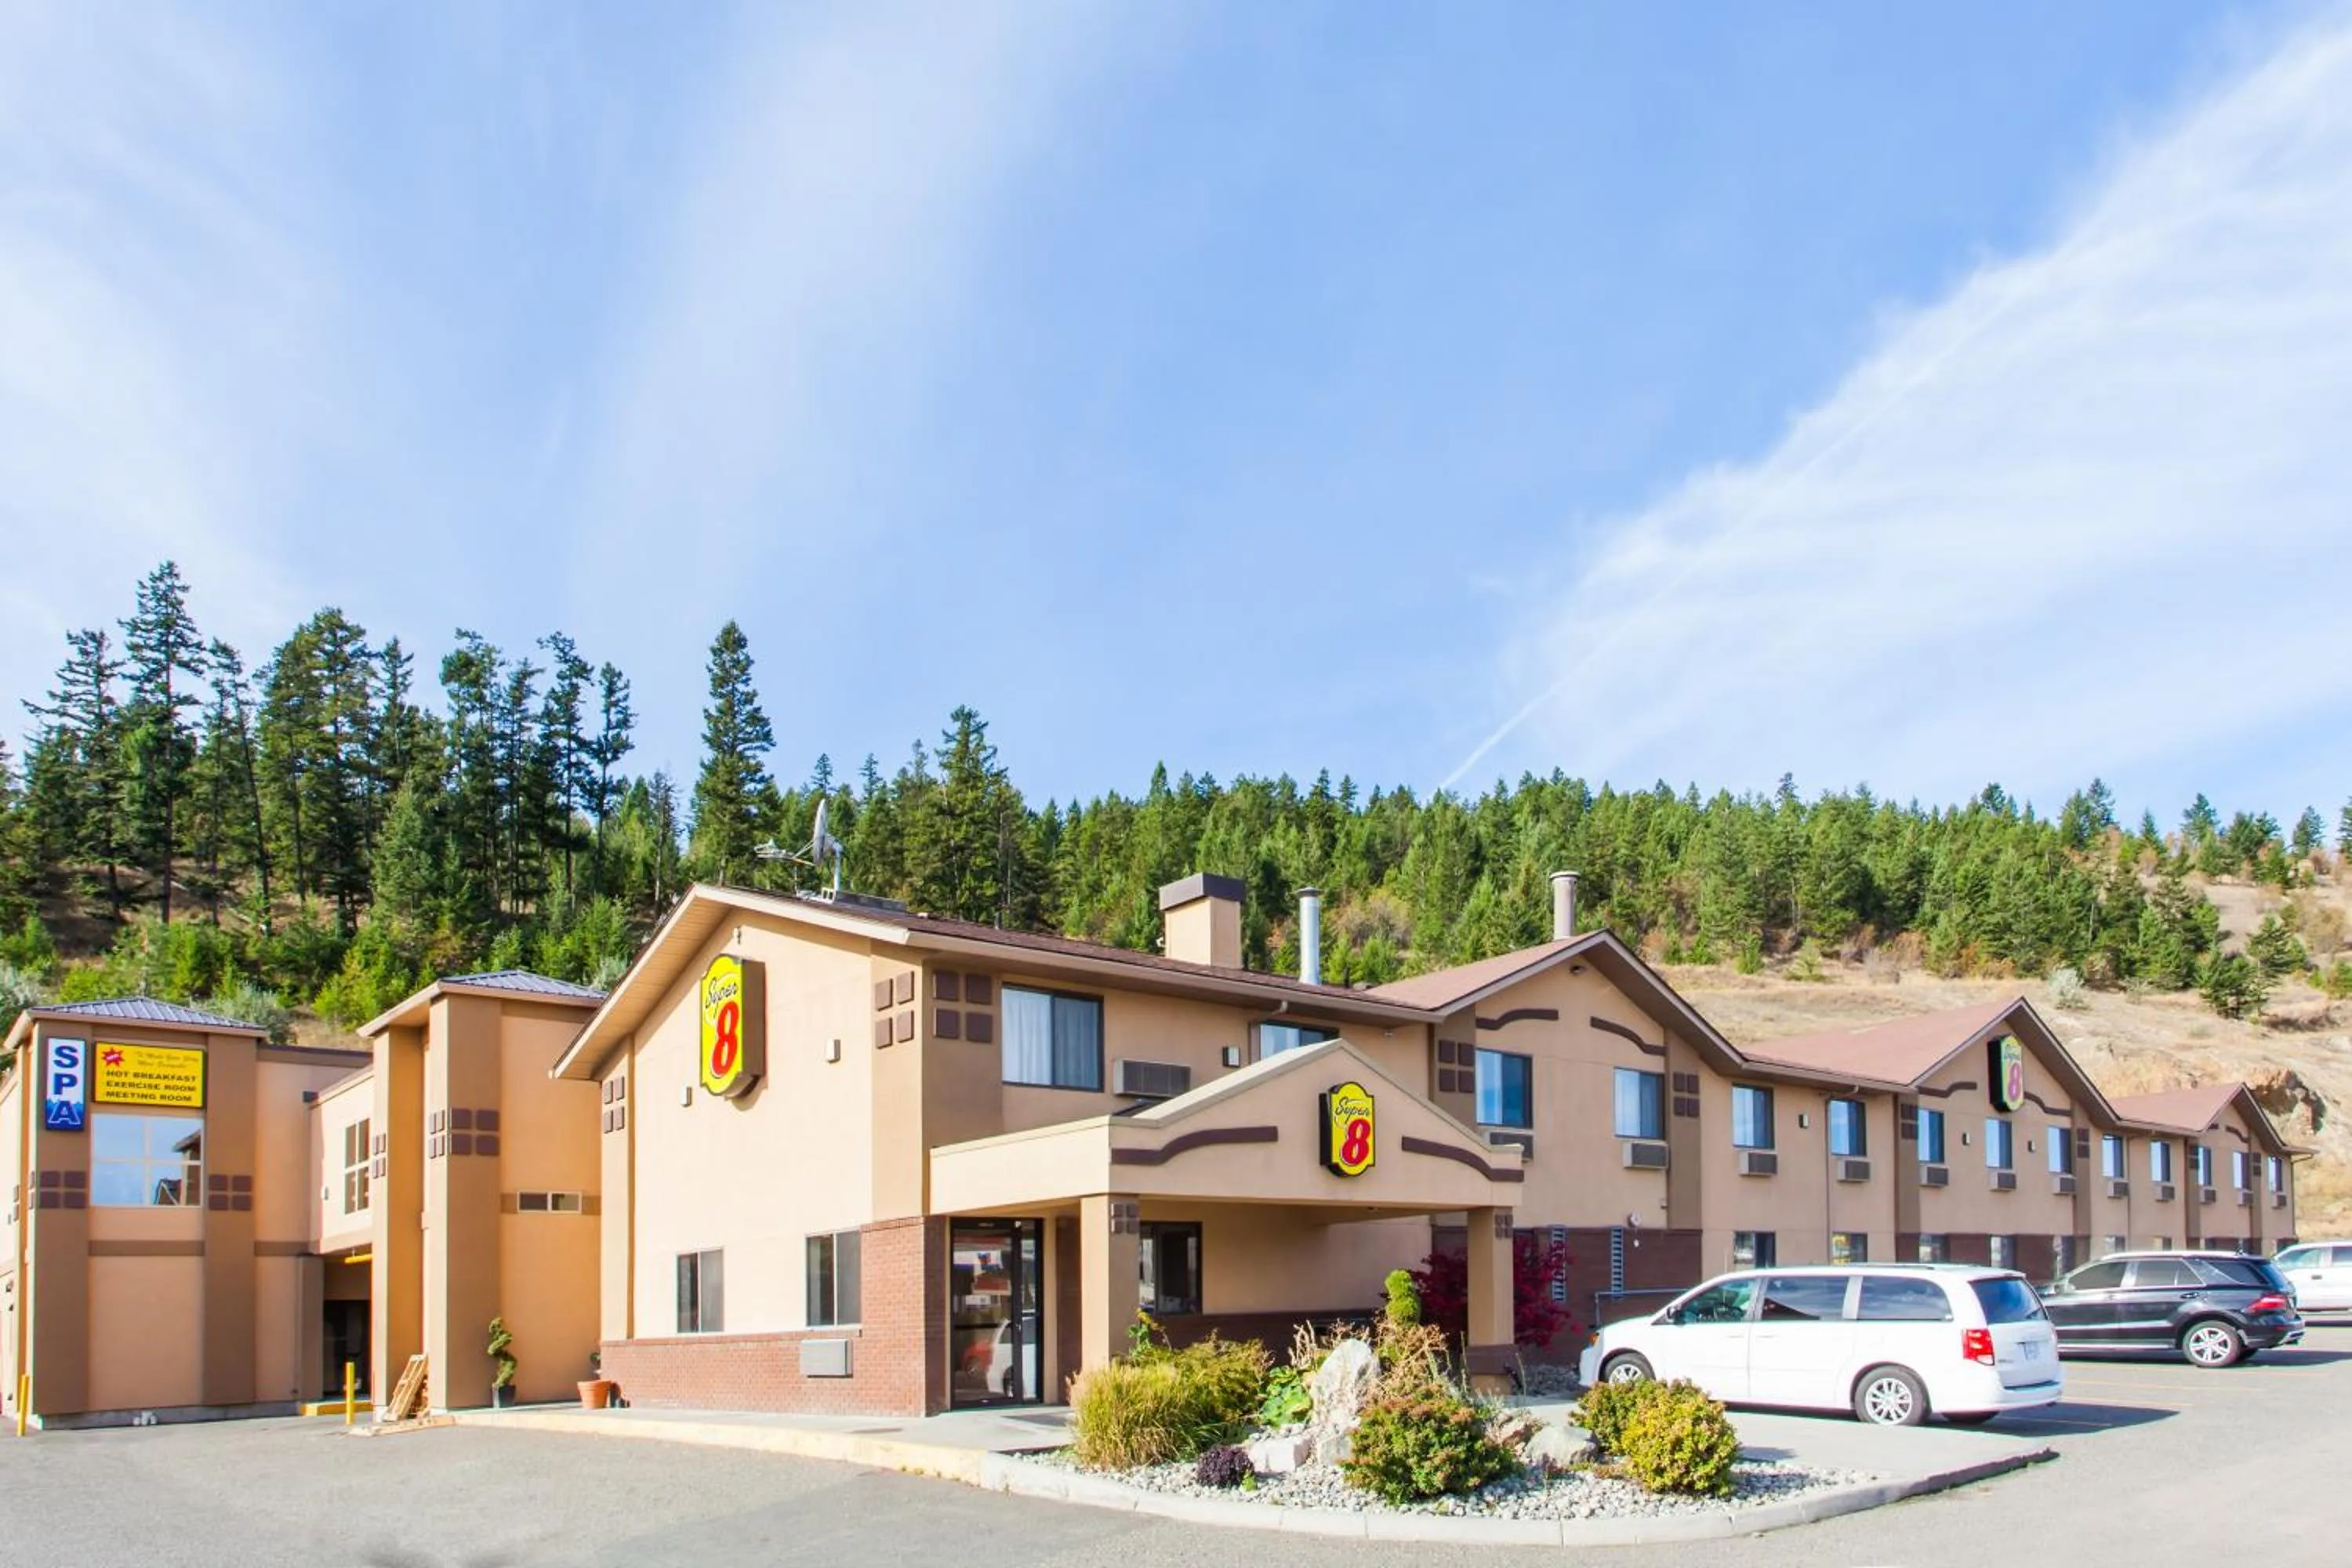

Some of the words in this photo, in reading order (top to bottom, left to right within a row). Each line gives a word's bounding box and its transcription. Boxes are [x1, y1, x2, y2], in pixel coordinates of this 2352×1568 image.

[706, 976, 738, 1018] Super
[712, 1001, 739, 1078] 8
[48, 1045, 81, 1125] SPA
[106, 1081, 161, 1091] EXERCISE
[106, 1091, 156, 1100] MEETING
[132, 1072, 196, 1082] BREAKFAST
[2008, 1062, 2020, 1102] 8
[1335, 1096, 1370, 1124] Super
[1340, 1119, 1371, 1167] 8
